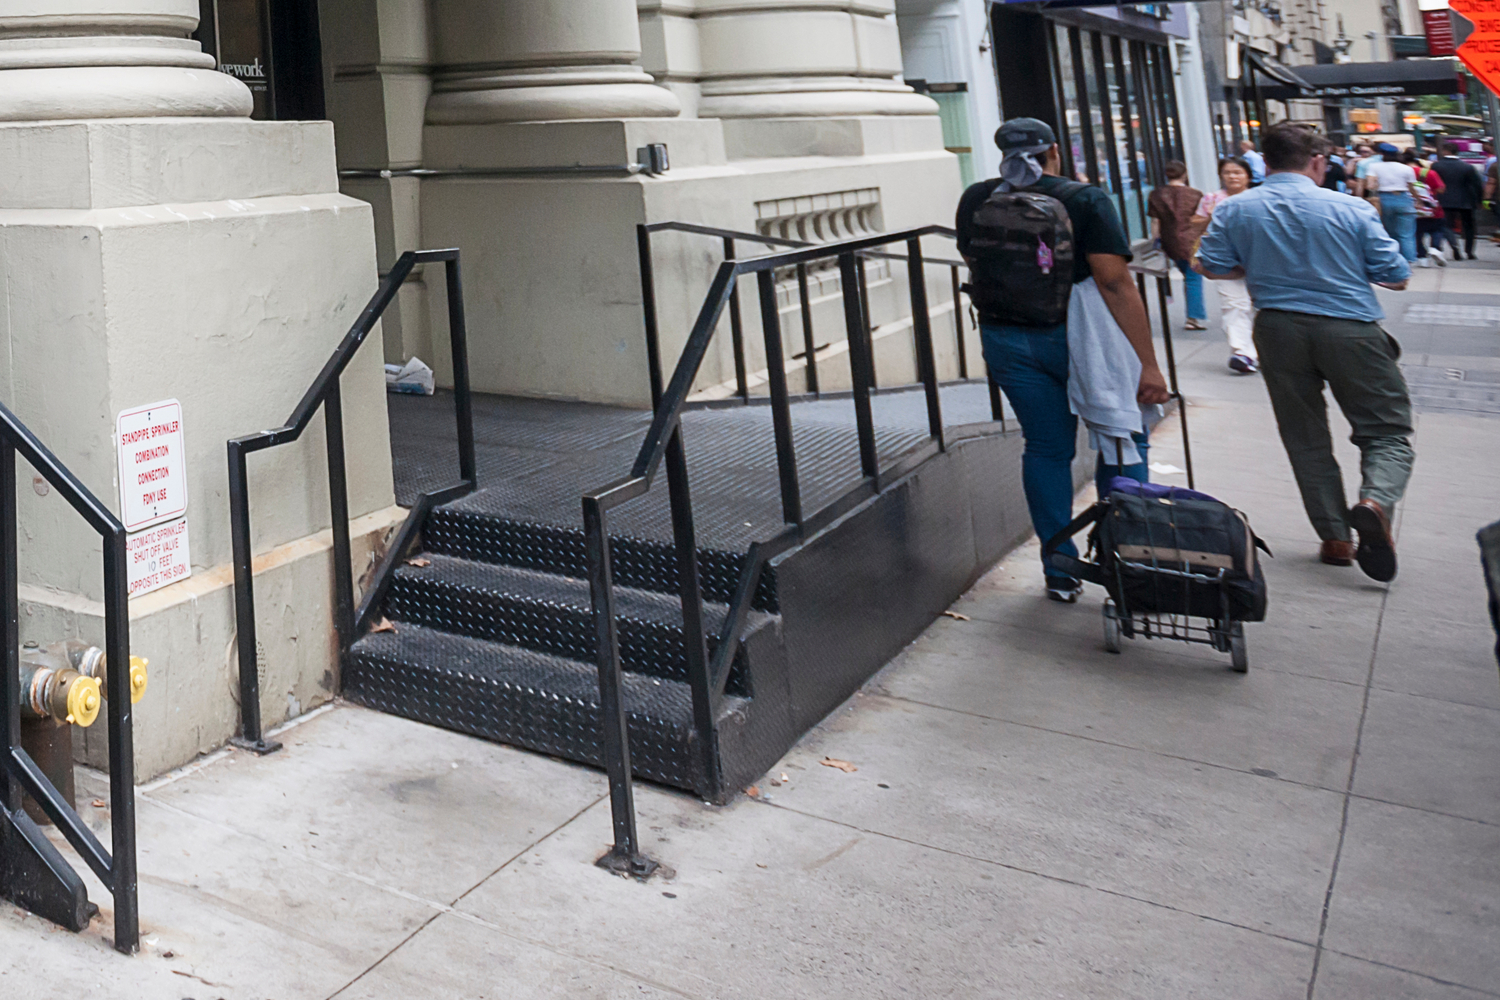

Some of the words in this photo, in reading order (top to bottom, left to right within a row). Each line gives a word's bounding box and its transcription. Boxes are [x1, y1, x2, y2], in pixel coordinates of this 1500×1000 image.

[135, 444, 169, 464] COMBINATION
[138, 465, 169, 485] CONNECTION
[142, 491, 156, 506] FDNY
[156, 487, 167, 501] USE
[157, 522, 186, 541] SPRINKLER
[134, 548, 149, 564] SHUT
[150, 545, 161, 558] OFF
[162, 537, 179, 553] VALVE
[148, 560, 156, 572] 10
[159, 553, 173, 568] FEET
[130, 573, 159, 593] OPPOSITE
[160, 567, 172, 582] THIS
